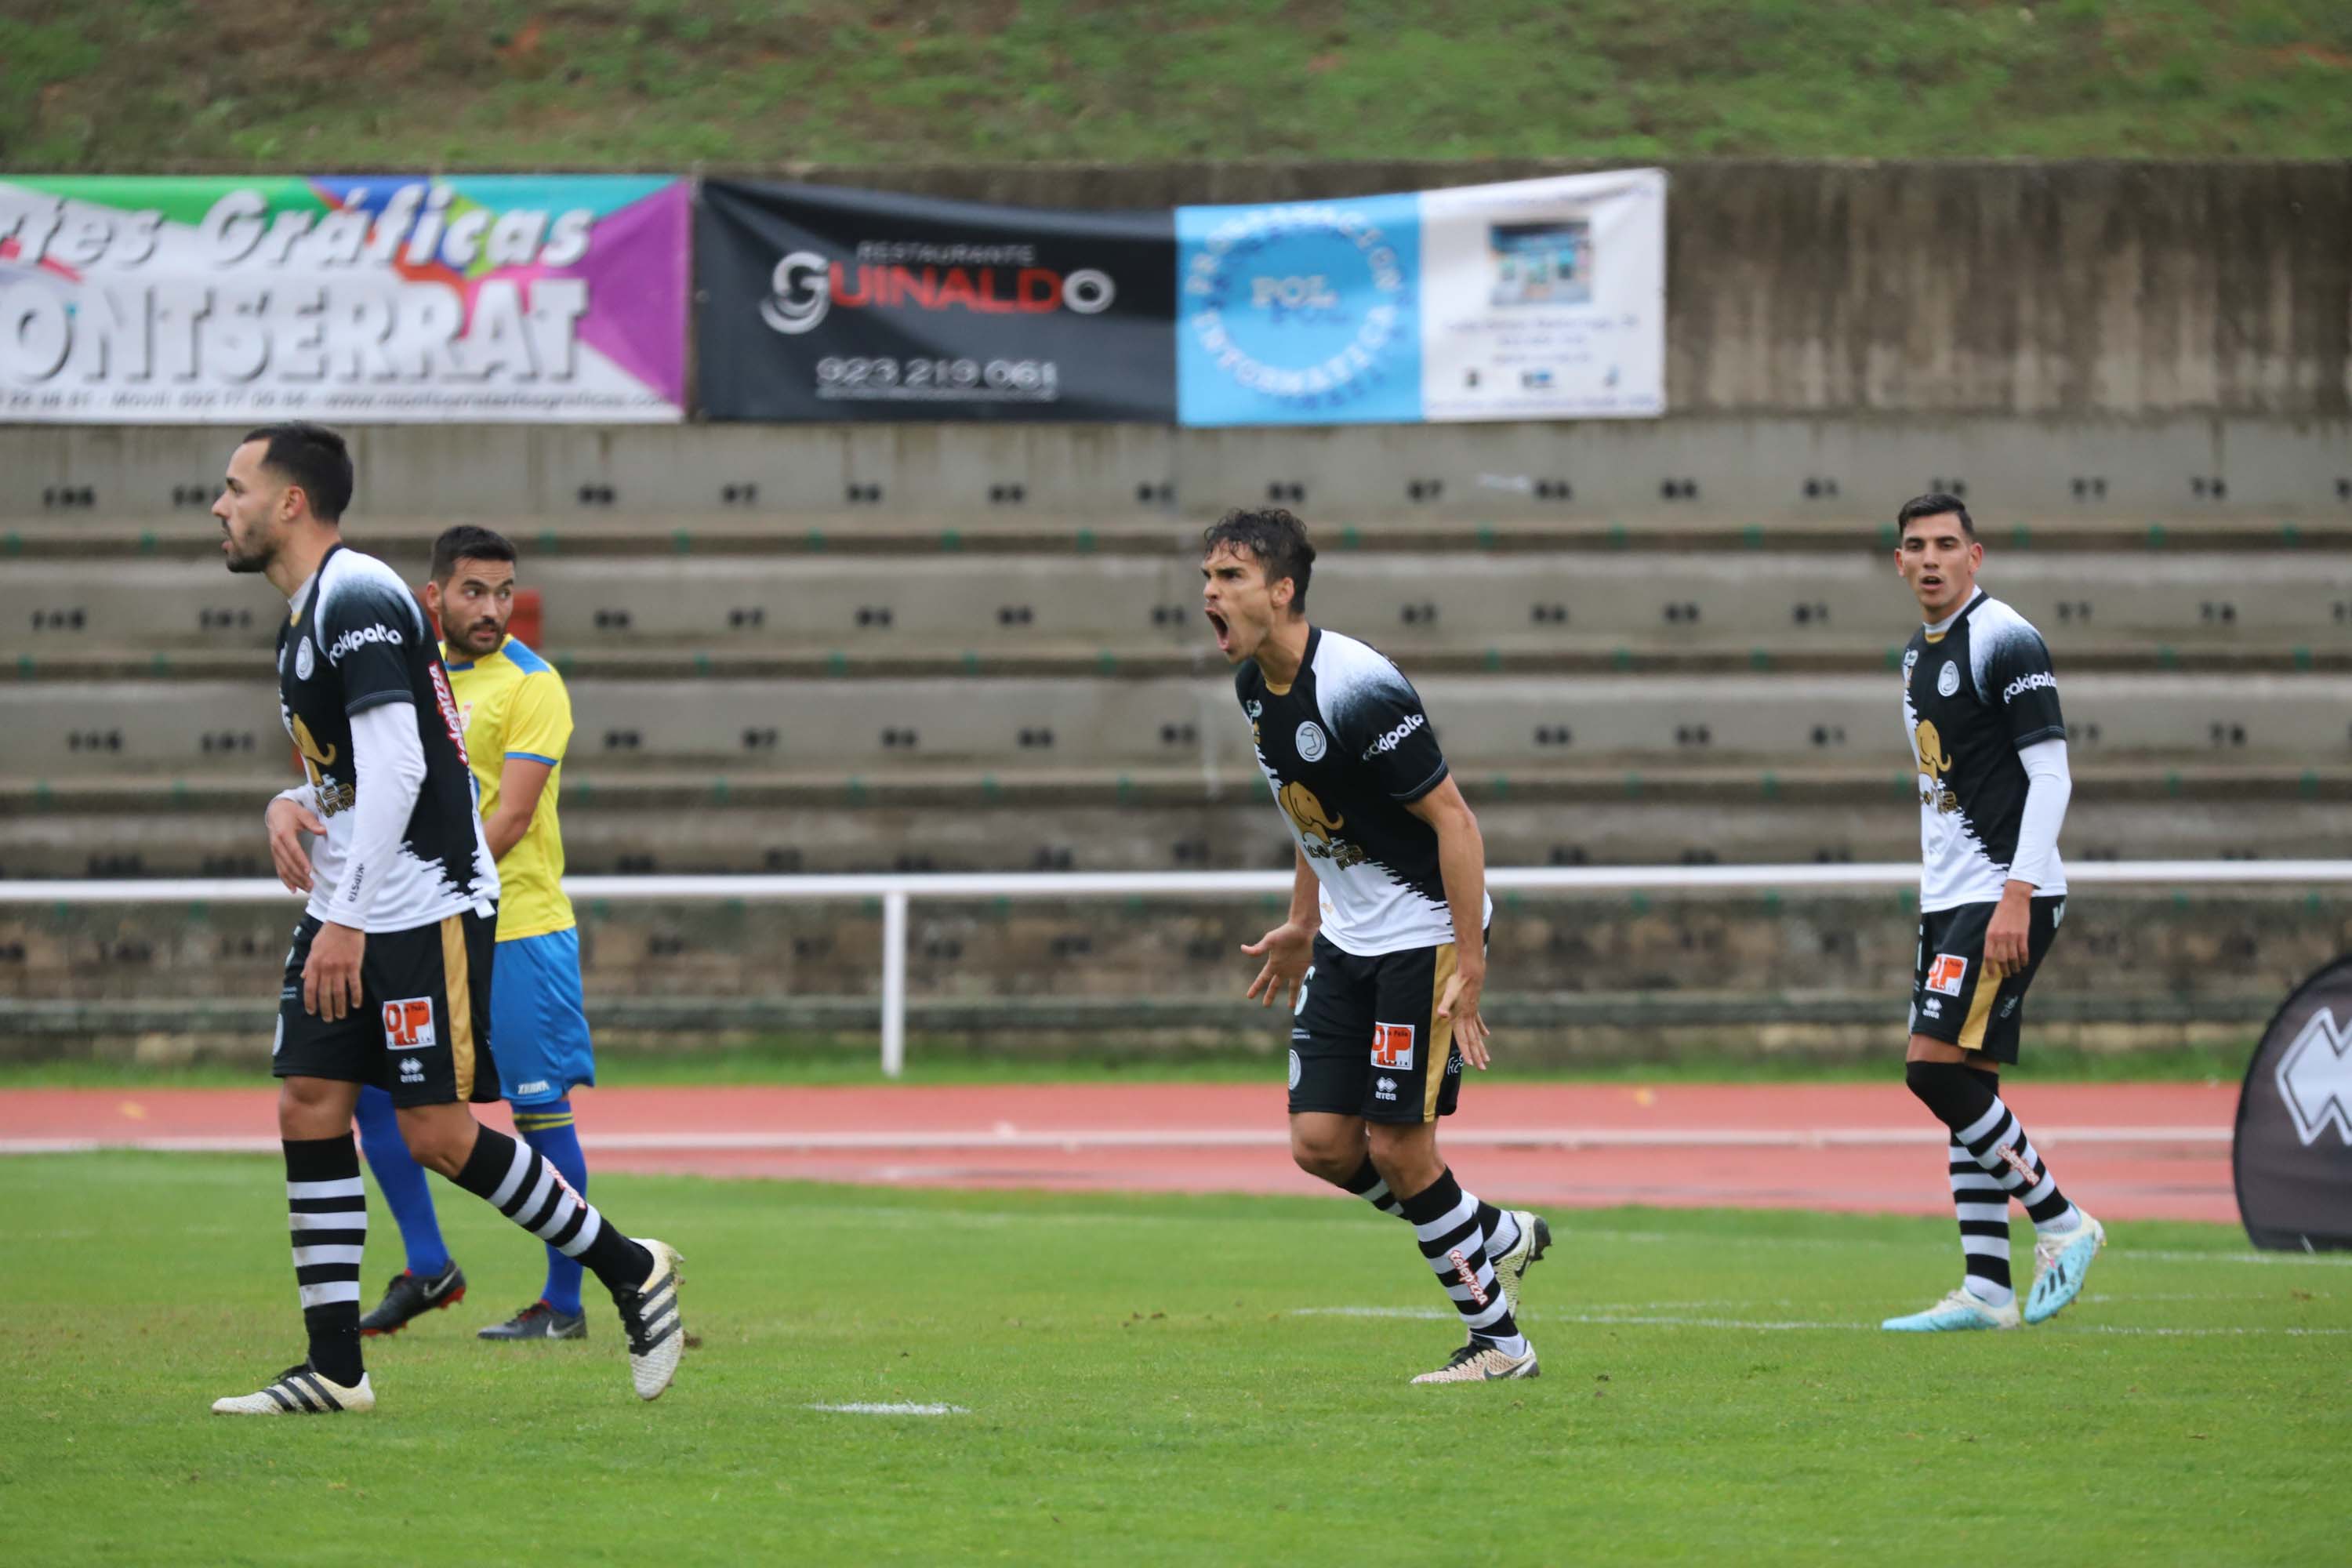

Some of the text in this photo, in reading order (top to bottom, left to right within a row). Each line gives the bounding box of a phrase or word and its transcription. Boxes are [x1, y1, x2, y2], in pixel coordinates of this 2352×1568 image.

[199, 184, 596, 267] Gráficas
[857, 241, 1036, 264] RESTAURANTE
[760, 250, 1116, 334] GUINALDO
[1250, 275, 1338, 308] POL
[1449, 1250, 1489, 1308] telepizza
